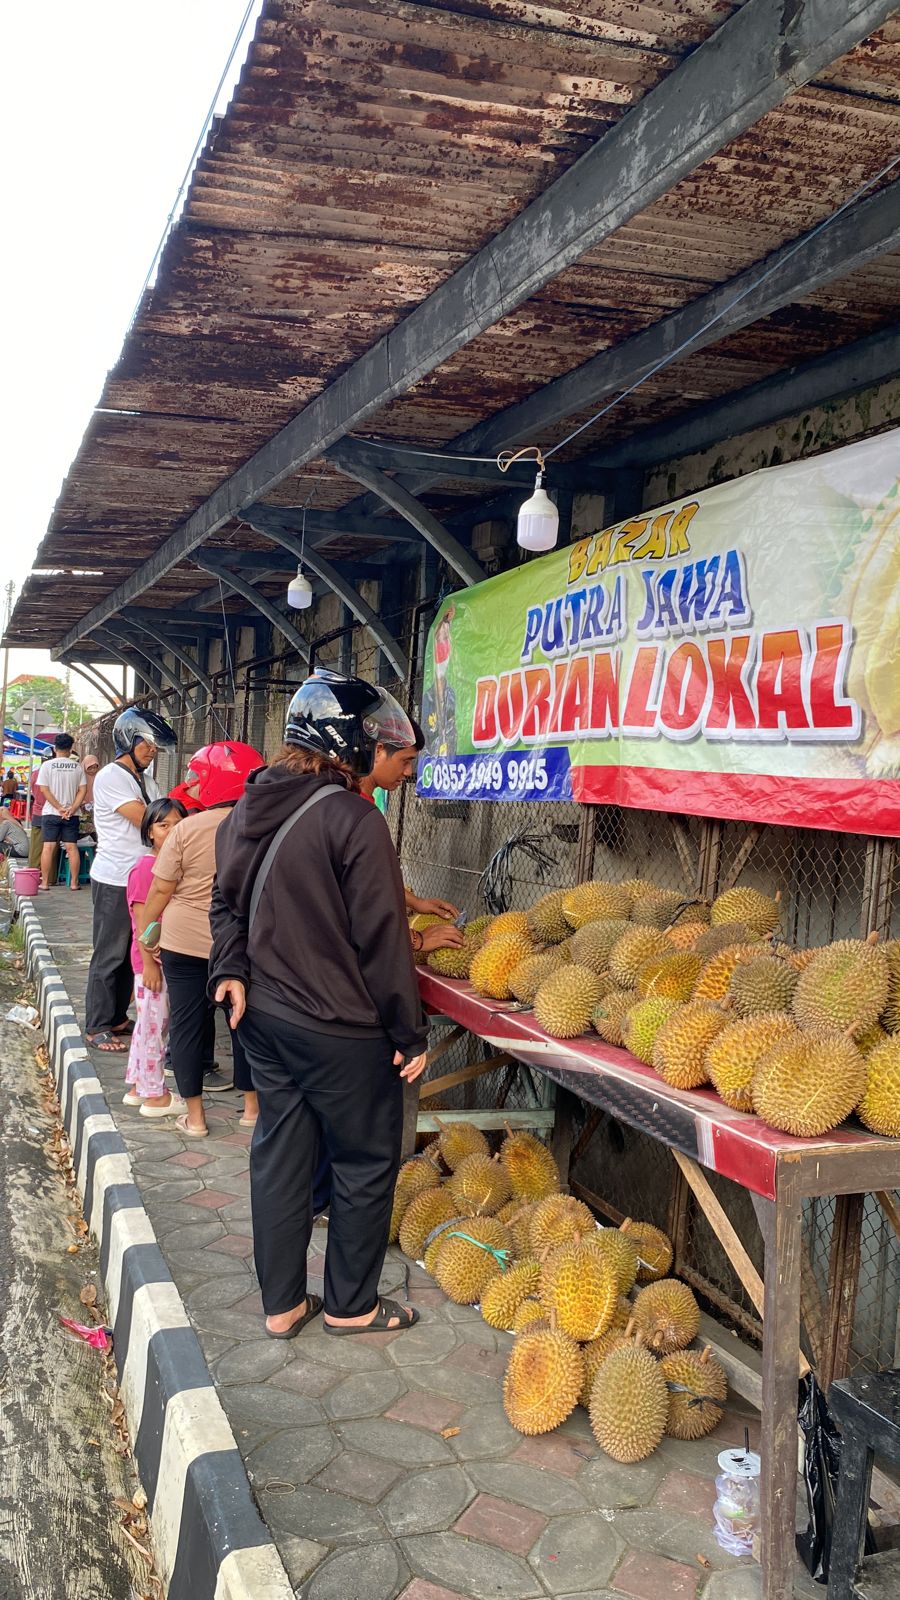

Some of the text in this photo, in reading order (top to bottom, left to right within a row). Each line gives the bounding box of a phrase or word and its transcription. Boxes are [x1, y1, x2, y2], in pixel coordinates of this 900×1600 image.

[568, 501, 700, 584] BAZAR
[521, 549, 748, 657] PUTRA JAWA
[473, 623, 853, 742] DURIAN LOKAL
[433, 763, 467, 790] 0853
